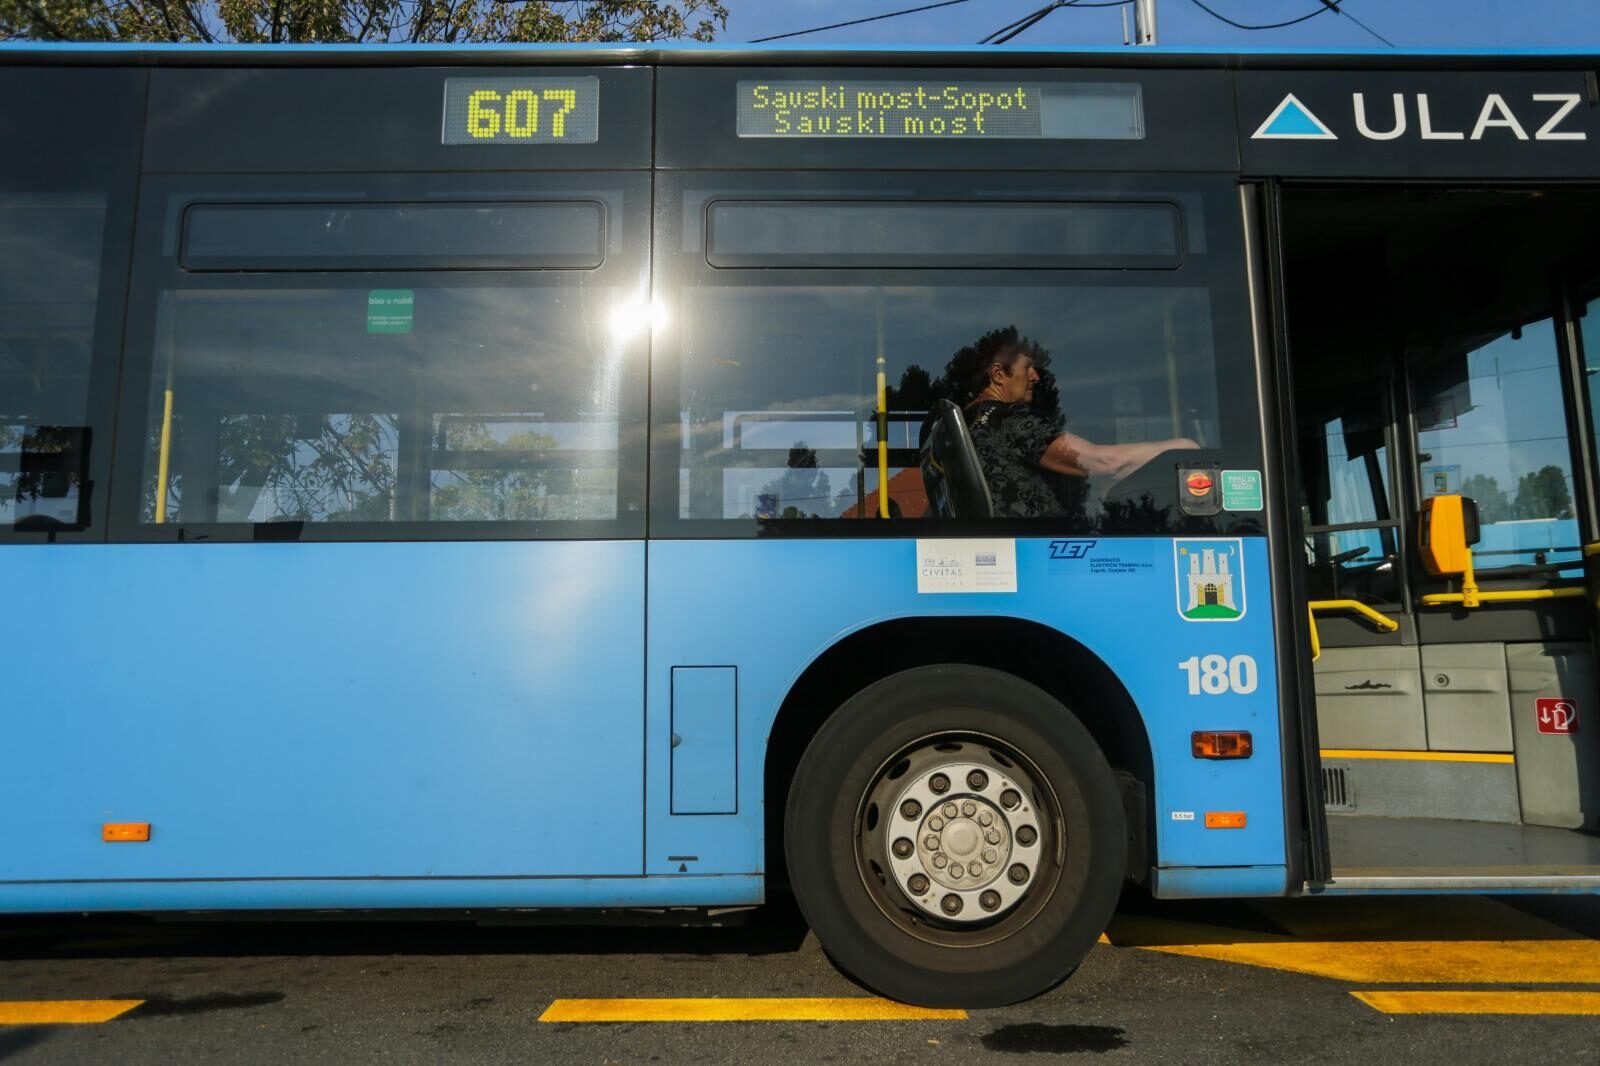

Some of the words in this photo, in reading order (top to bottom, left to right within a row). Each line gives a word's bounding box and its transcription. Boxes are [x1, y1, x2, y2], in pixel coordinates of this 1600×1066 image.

[753, 85, 845, 109] Savski
[857, 85, 1027, 113] most-Sopot
[467, 89, 576, 138] 607
[775, 110, 884, 133] Savski
[904, 111, 986, 134] most
[1352, 93, 1588, 140] ULAZ
[1049, 540, 1097, 559] ZET
[922, 568, 963, 577] CIVITAS
[1178, 654, 1258, 695] 180
